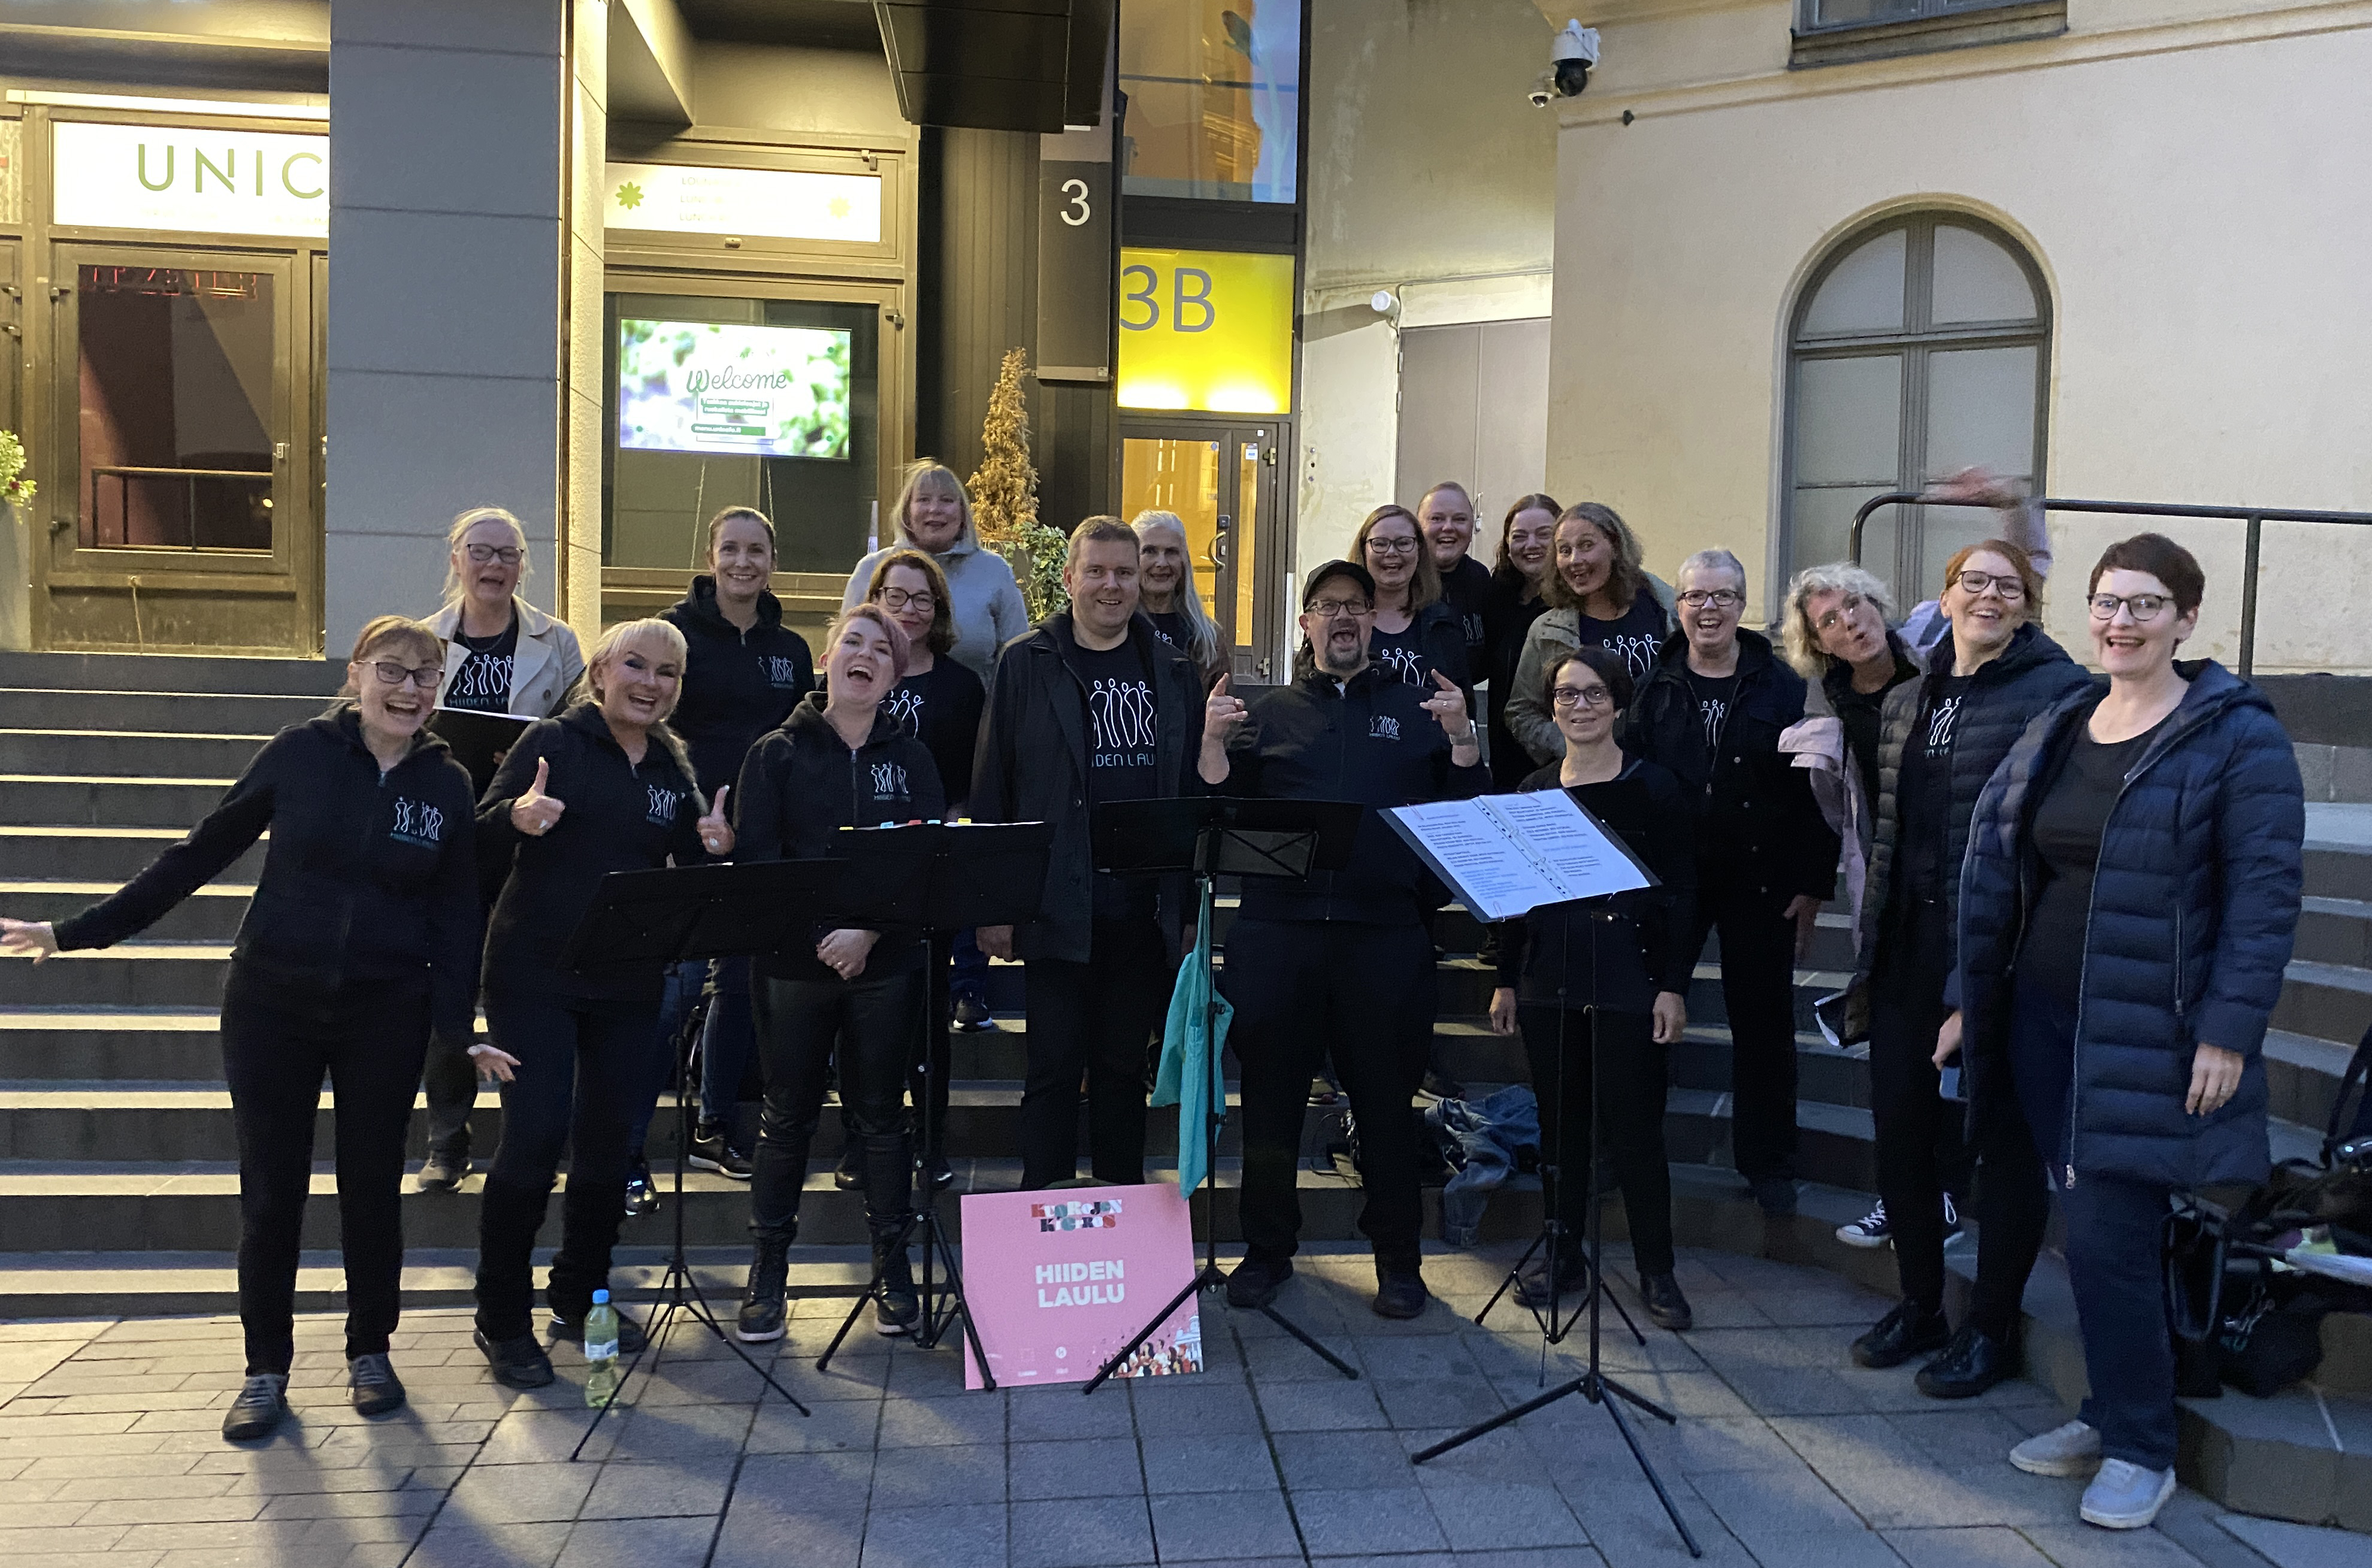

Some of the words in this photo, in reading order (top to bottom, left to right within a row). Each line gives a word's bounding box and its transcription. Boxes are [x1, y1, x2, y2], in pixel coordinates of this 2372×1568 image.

[138, 143, 325, 199] UNIC
[1060, 178, 1091, 226] 3
[1120, 264, 1216, 333] 3B
[686, 365, 787, 393] Welcome
[1035, 1260, 1124, 1285] HIIDEN
[1038, 1282, 1125, 1308] LAULU
